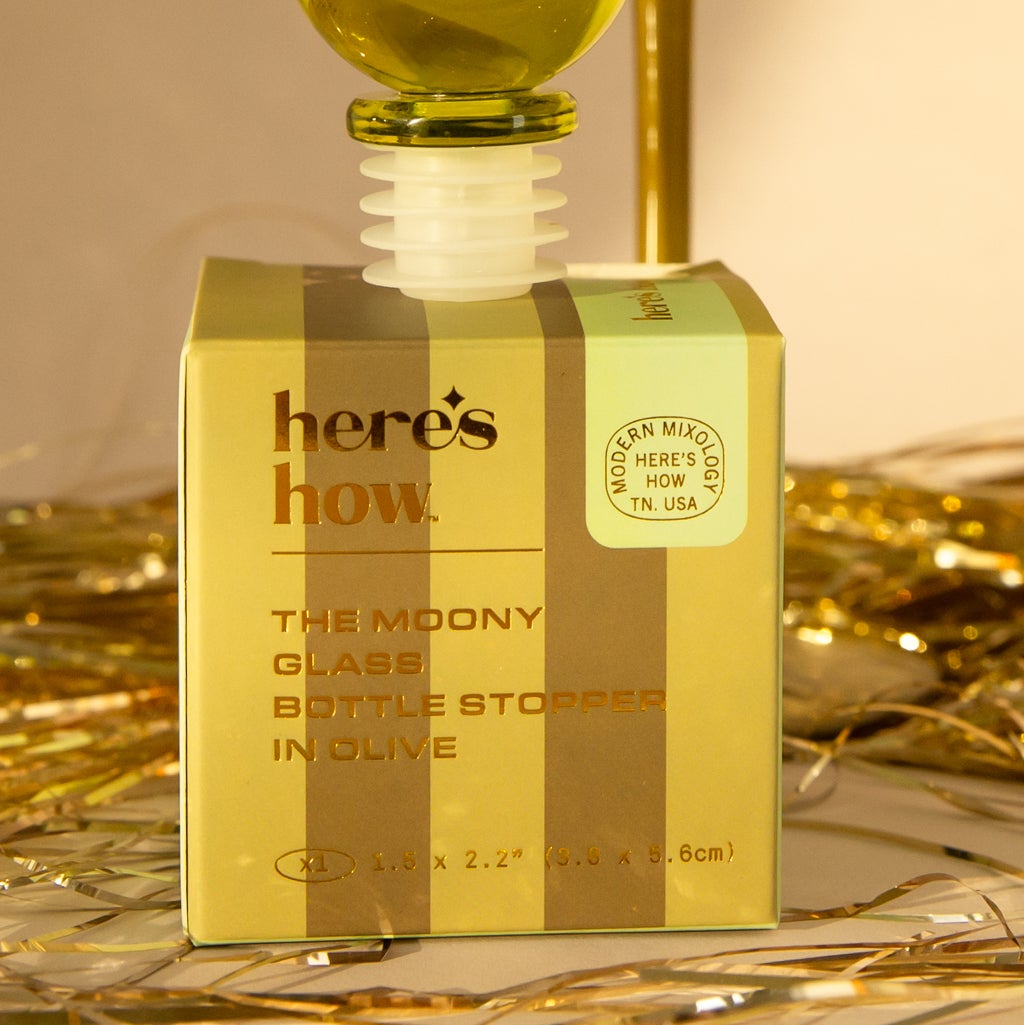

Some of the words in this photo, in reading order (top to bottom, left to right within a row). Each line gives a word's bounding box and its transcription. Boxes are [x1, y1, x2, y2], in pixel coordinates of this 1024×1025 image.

[610, 422, 655, 495] MODERN
[662, 421, 720, 495] MIXOLOGY
[635, 451, 697, 468] HERE'S
[646, 473, 686, 489] HOW
[630, 496, 658, 512] TN.
[664, 496, 698, 512] USA
[271, 609, 361, 633] THE
[371, 606, 544, 633] MOONY
[272, 652, 425, 677] GLASS
[273, 693, 448, 720] BOTTLE
[458, 689, 668, 718] STOPPER
[273, 738, 317, 763] IN
[328, 736, 458, 762] OLIVE
[433, 854, 449, 870] x
[647, 839, 735, 866] 5.6cm)
